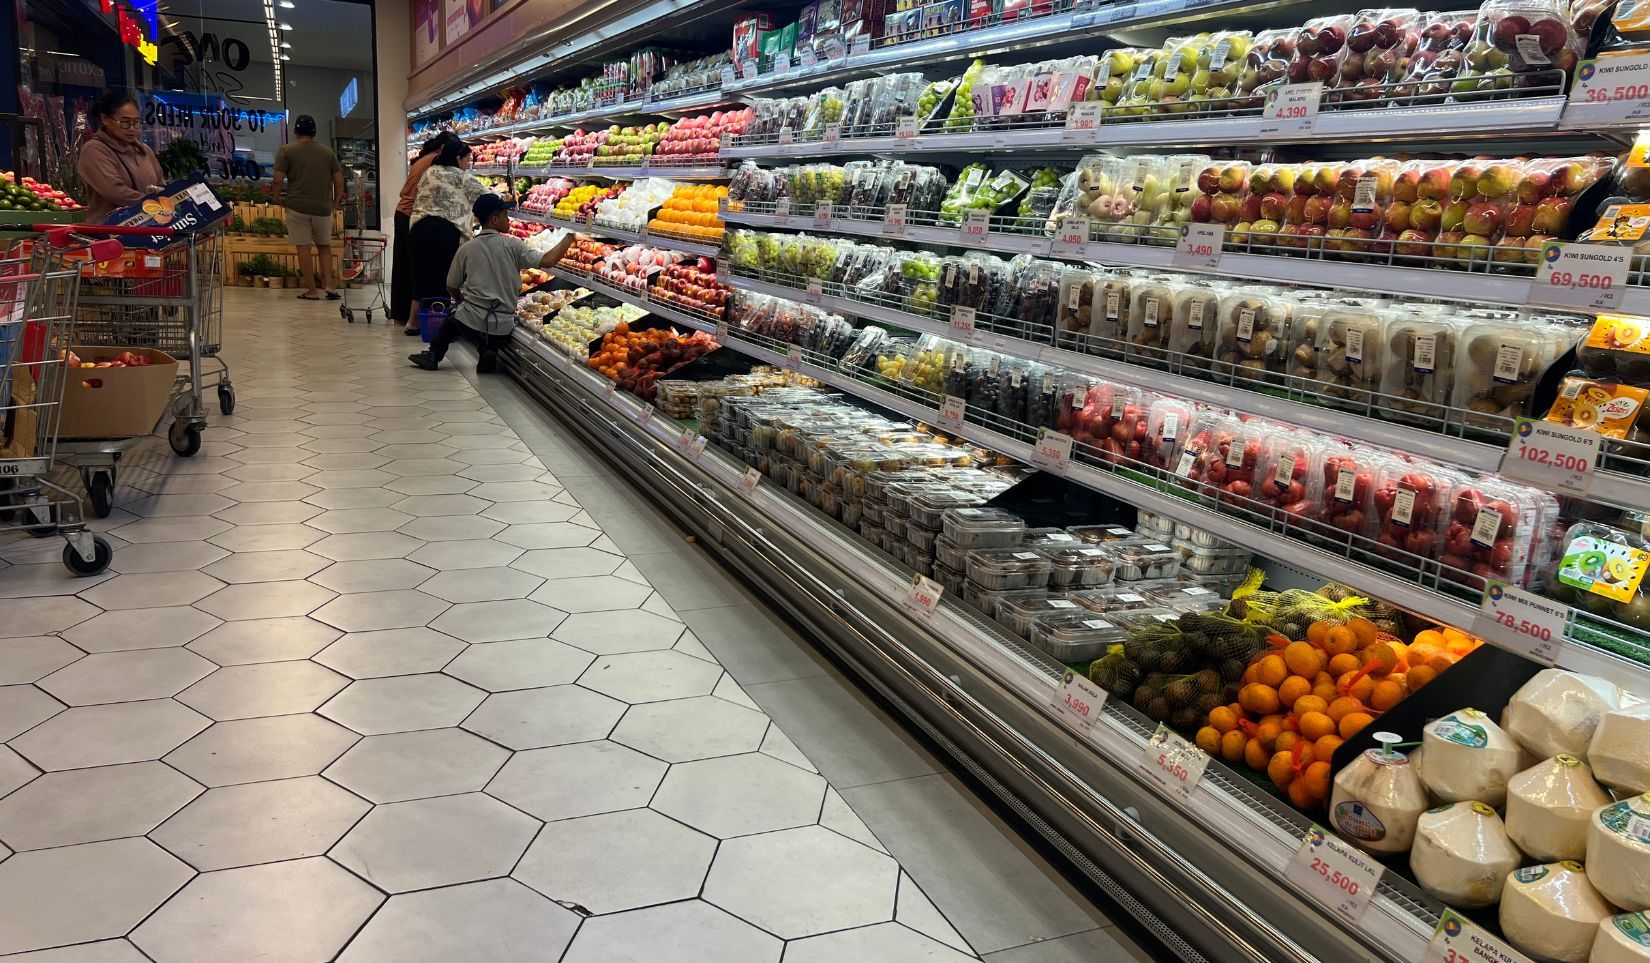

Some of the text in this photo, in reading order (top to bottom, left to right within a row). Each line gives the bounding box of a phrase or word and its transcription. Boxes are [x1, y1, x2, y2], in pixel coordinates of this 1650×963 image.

[1615, 64, 1648, 73] SUNGOLD
[1585, 84, 1649, 103] 36,500
[1276, 106, 1307, 119] 4,390
[151, 213, 197, 244] Sunist
[1062, 234, 1082, 244] 4,050
[1187, 244, 1213, 256] 3,490
[1580, 254, 1612, 262] SUNGOLD
[1550, 271, 1613, 290] 69,500
[1606, 403, 1628, 414] Zespri
[1536, 429, 1549, 437] KIWI
[1551, 432, 1582, 443] SUNGOLD
[1519, 446, 1587, 472] 102,500
[1504, 593, 1517, 601] KIWI
[1518, 598, 1528, 606] MIX
[1529, 602, 1554, 614] PUNNET
[1495, 610, 1551, 641] 78,500
[1064, 693, 1090, 716] 3,990
[1157, 753, 1188, 781] 5,350
[1327, 841, 1347, 858] KELAPA
[1348, 855, 1365, 869] KULIT
[1310, 857, 1359, 896] 25,500
[1471, 935, 1498, 956] KELAPA
